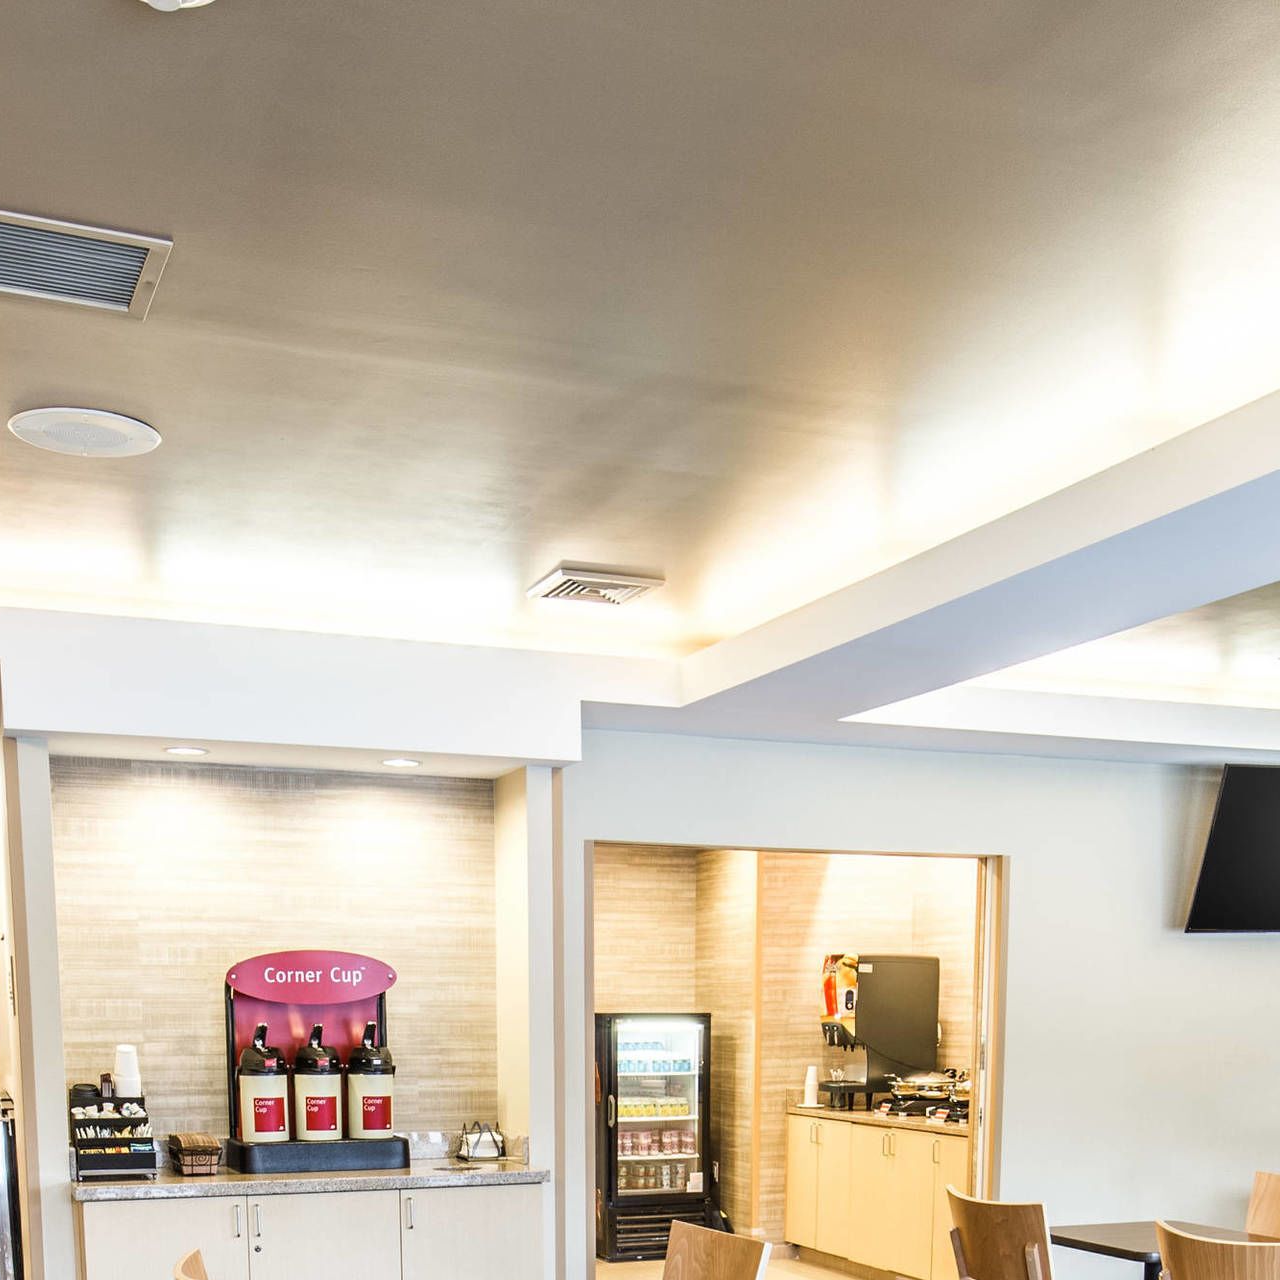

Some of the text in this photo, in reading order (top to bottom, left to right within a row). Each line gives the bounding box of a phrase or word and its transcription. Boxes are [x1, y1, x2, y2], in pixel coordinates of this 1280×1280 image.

[264, 967, 323, 983] Corner
[255, 1098, 275, 1106] Corner
[363, 1097, 383, 1105] Corner
[306, 1105, 319, 1113] Cup
[363, 1104, 376, 1112] Cup
